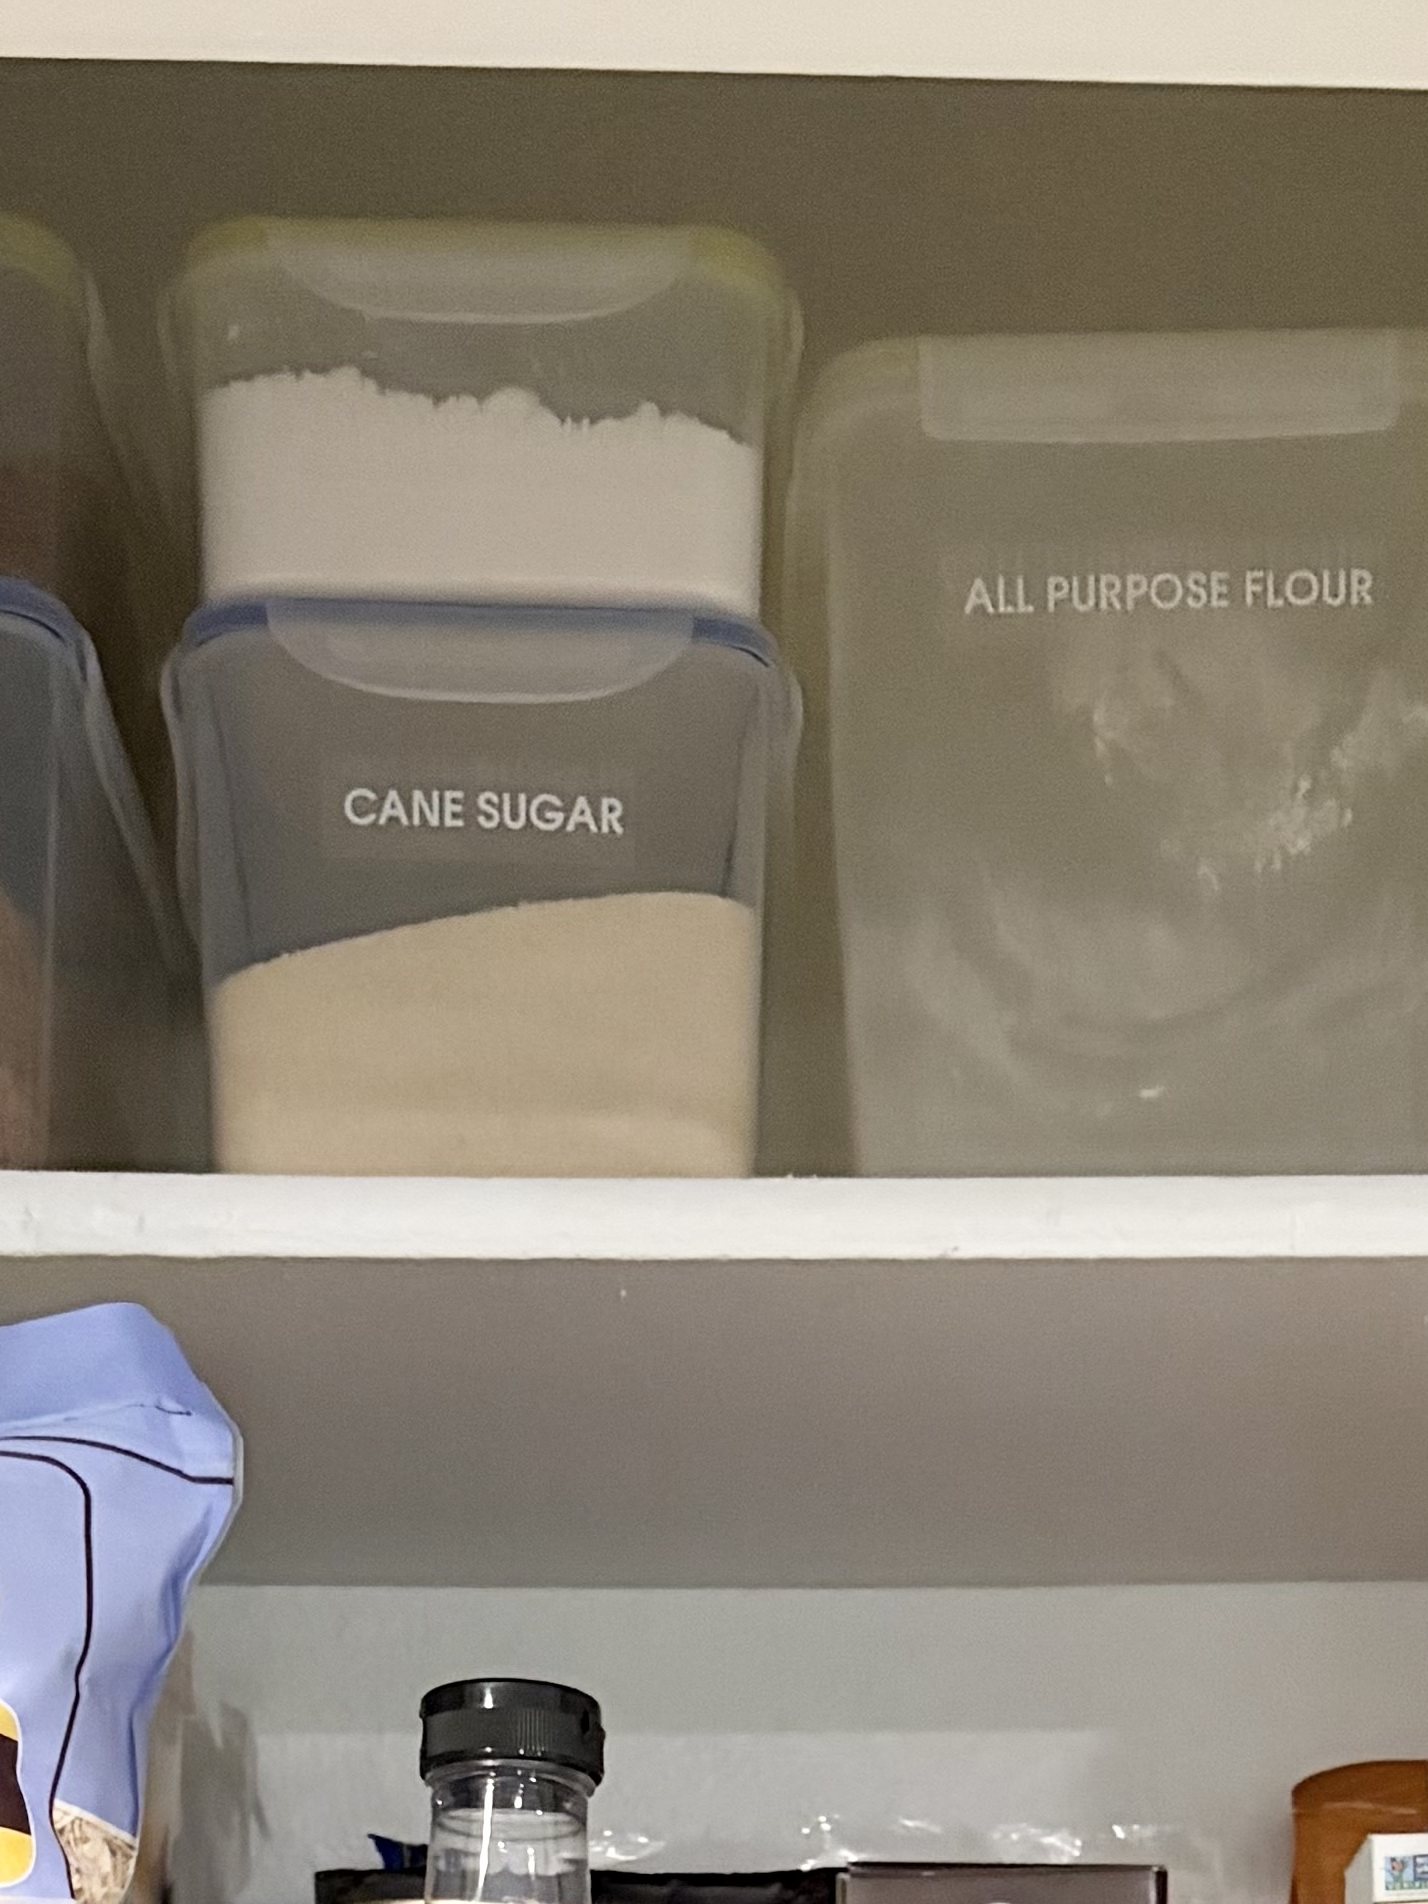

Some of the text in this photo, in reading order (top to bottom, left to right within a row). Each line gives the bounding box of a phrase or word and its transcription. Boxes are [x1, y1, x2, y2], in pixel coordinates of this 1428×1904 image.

[965, 568, 1375, 614] ALL PURPOSE FLOUR
[344, 788, 624, 835] CANE SUGAR
